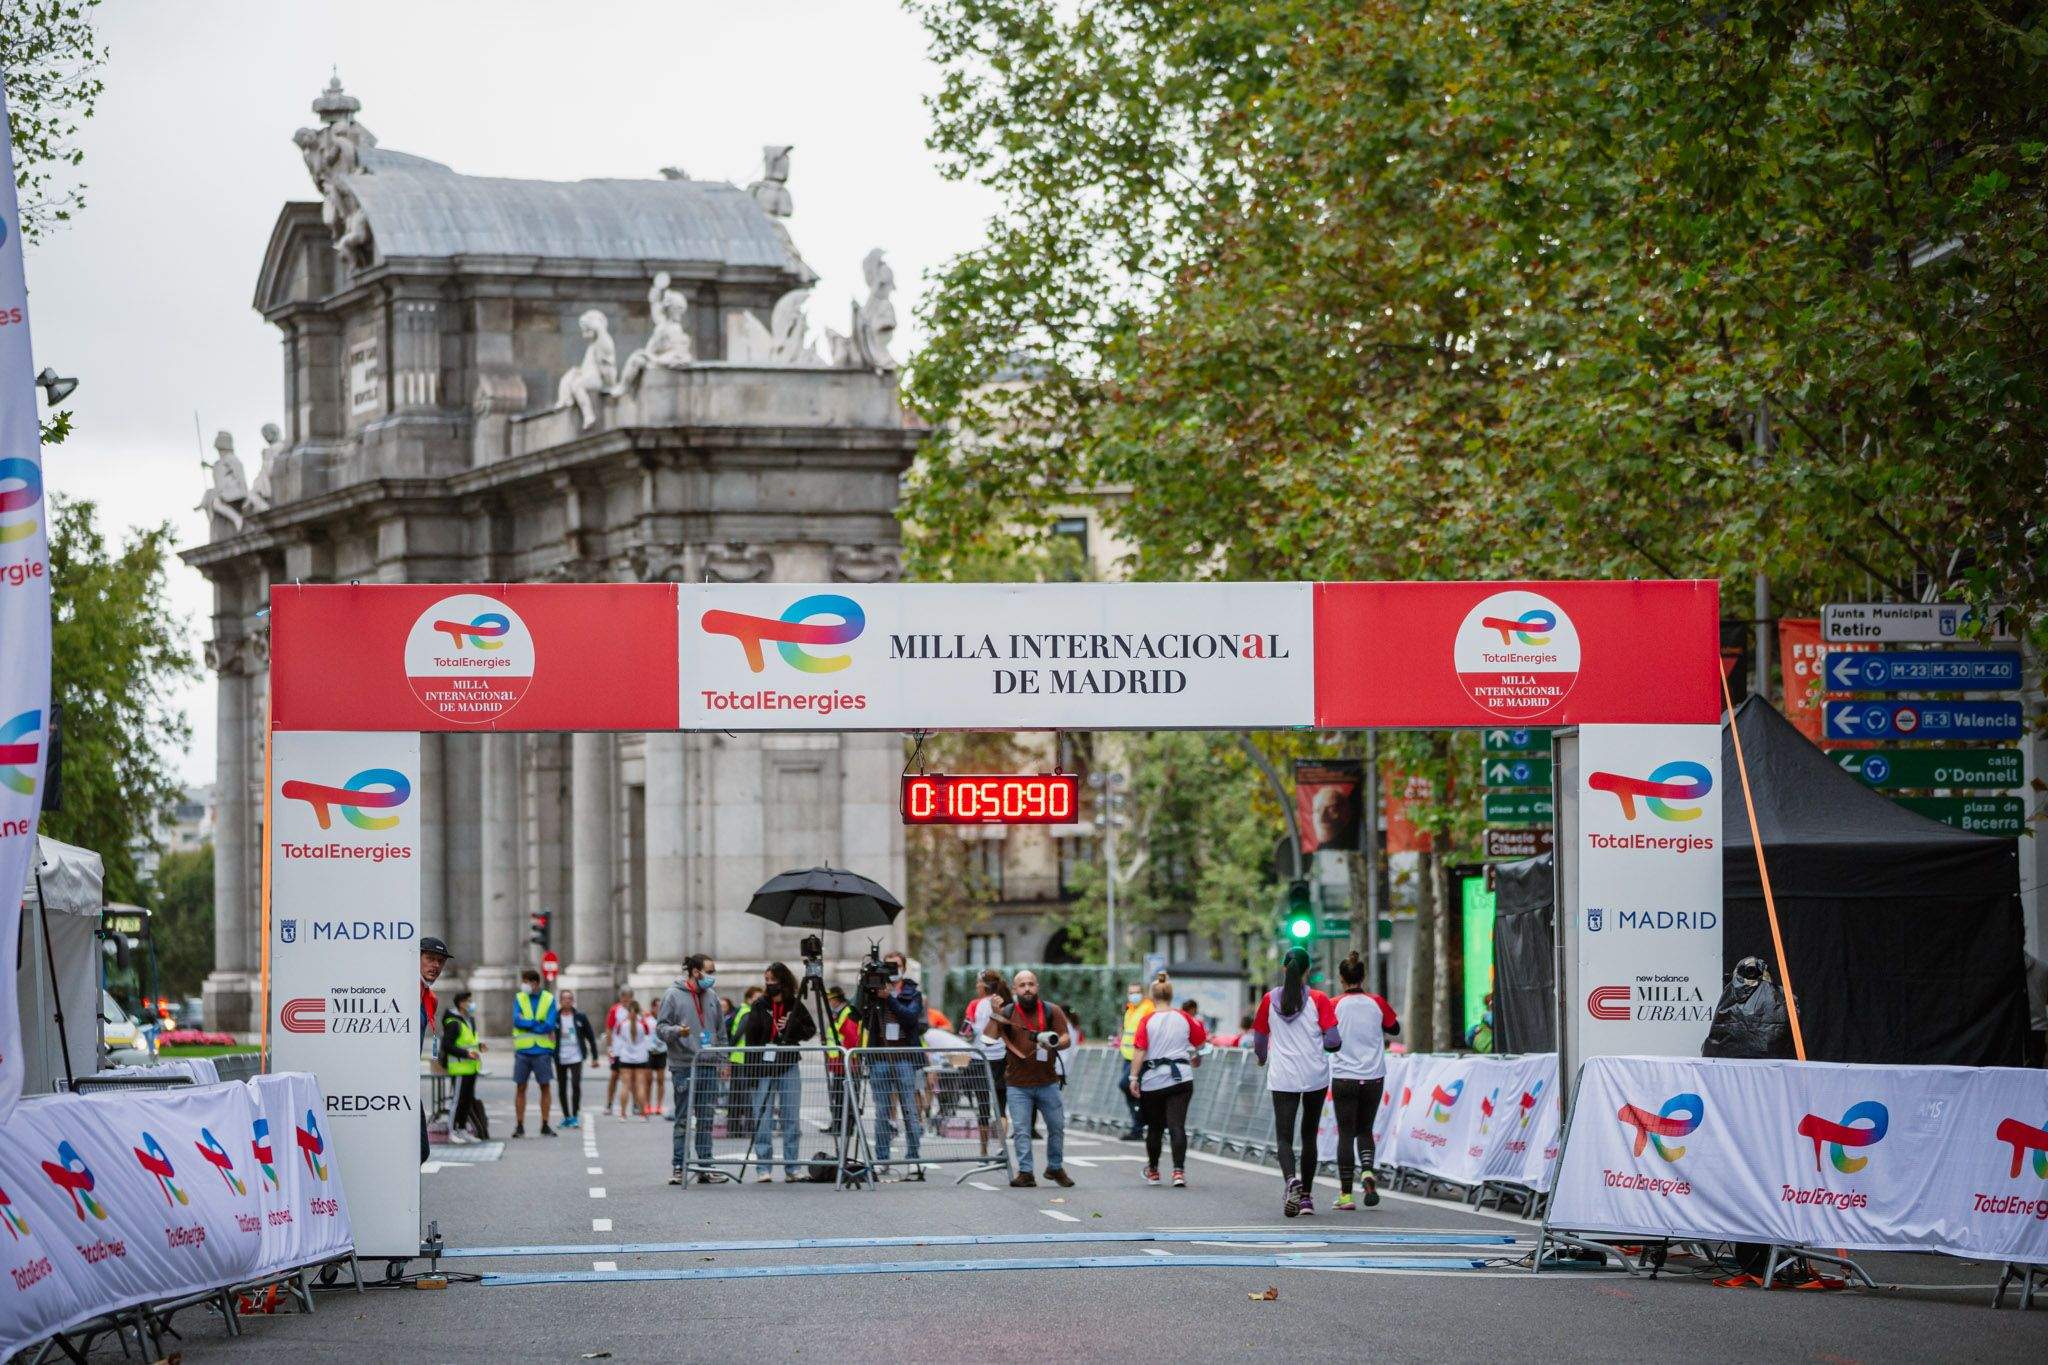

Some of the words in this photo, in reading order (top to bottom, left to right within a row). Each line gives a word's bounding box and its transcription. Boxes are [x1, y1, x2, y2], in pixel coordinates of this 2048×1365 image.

[1831, 608, 1865, 618] Junta
[1873, 608, 1933, 620] Municipal
[1831, 623, 1881, 637] Retiro
[889, 634, 1000, 659] MILLA
[434, 657, 511, 669] TotalEnergies
[1482, 653, 1557, 664] TotalEnergies
[1893, 665, 1927, 677] M-23
[1933, 665, 1968, 676] M-30
[1974, 664, 2010, 676] M-40
[453, 680, 489, 689] MILLA
[992, 669, 1040, 694] DE
[1049, 669, 1187, 694] MADRID
[1501, 675, 1536, 685] MILLA
[440, 702, 456, 712] DE
[457, 702, 503, 712] MADRID
[701, 690, 867, 715] TotalEnergies
[1488, 698, 1504, 707] DE
[1506, 698, 1550, 707] MADRID
[1924, 713, 1948, 725] R-3
[1954, 713, 2017, 727] Valencia
[1988, 756, 2018, 766] calle
[1934, 768, 2018, 782] O'Donnell
[1964, 802, 1996, 813] plaza
[2003, 803, 2018, 812] de
[1962, 816, 2018, 829] Becerra
[1588, 833, 1713, 853] TotalEnergies
[281, 843, 411, 863] TotalEnergies
[1619, 911, 1717, 929] MADRID
[313, 921, 415, 940] MADRID
[1655, 974, 1689, 983] balance
[350, 986, 386, 994] balance
[1637, 986, 1703, 1002] MILLA
[332, 998, 402, 1013] MILLA
[1636, 1005, 1714, 1021] URBANA
[332, 1017, 411, 1034] URBANA
[323, 1095, 412, 1111] REDORA
[1602, 1170, 1691, 1197] TotalEnergies
[1781, 1184, 1868, 1210] TotalEnrgies
